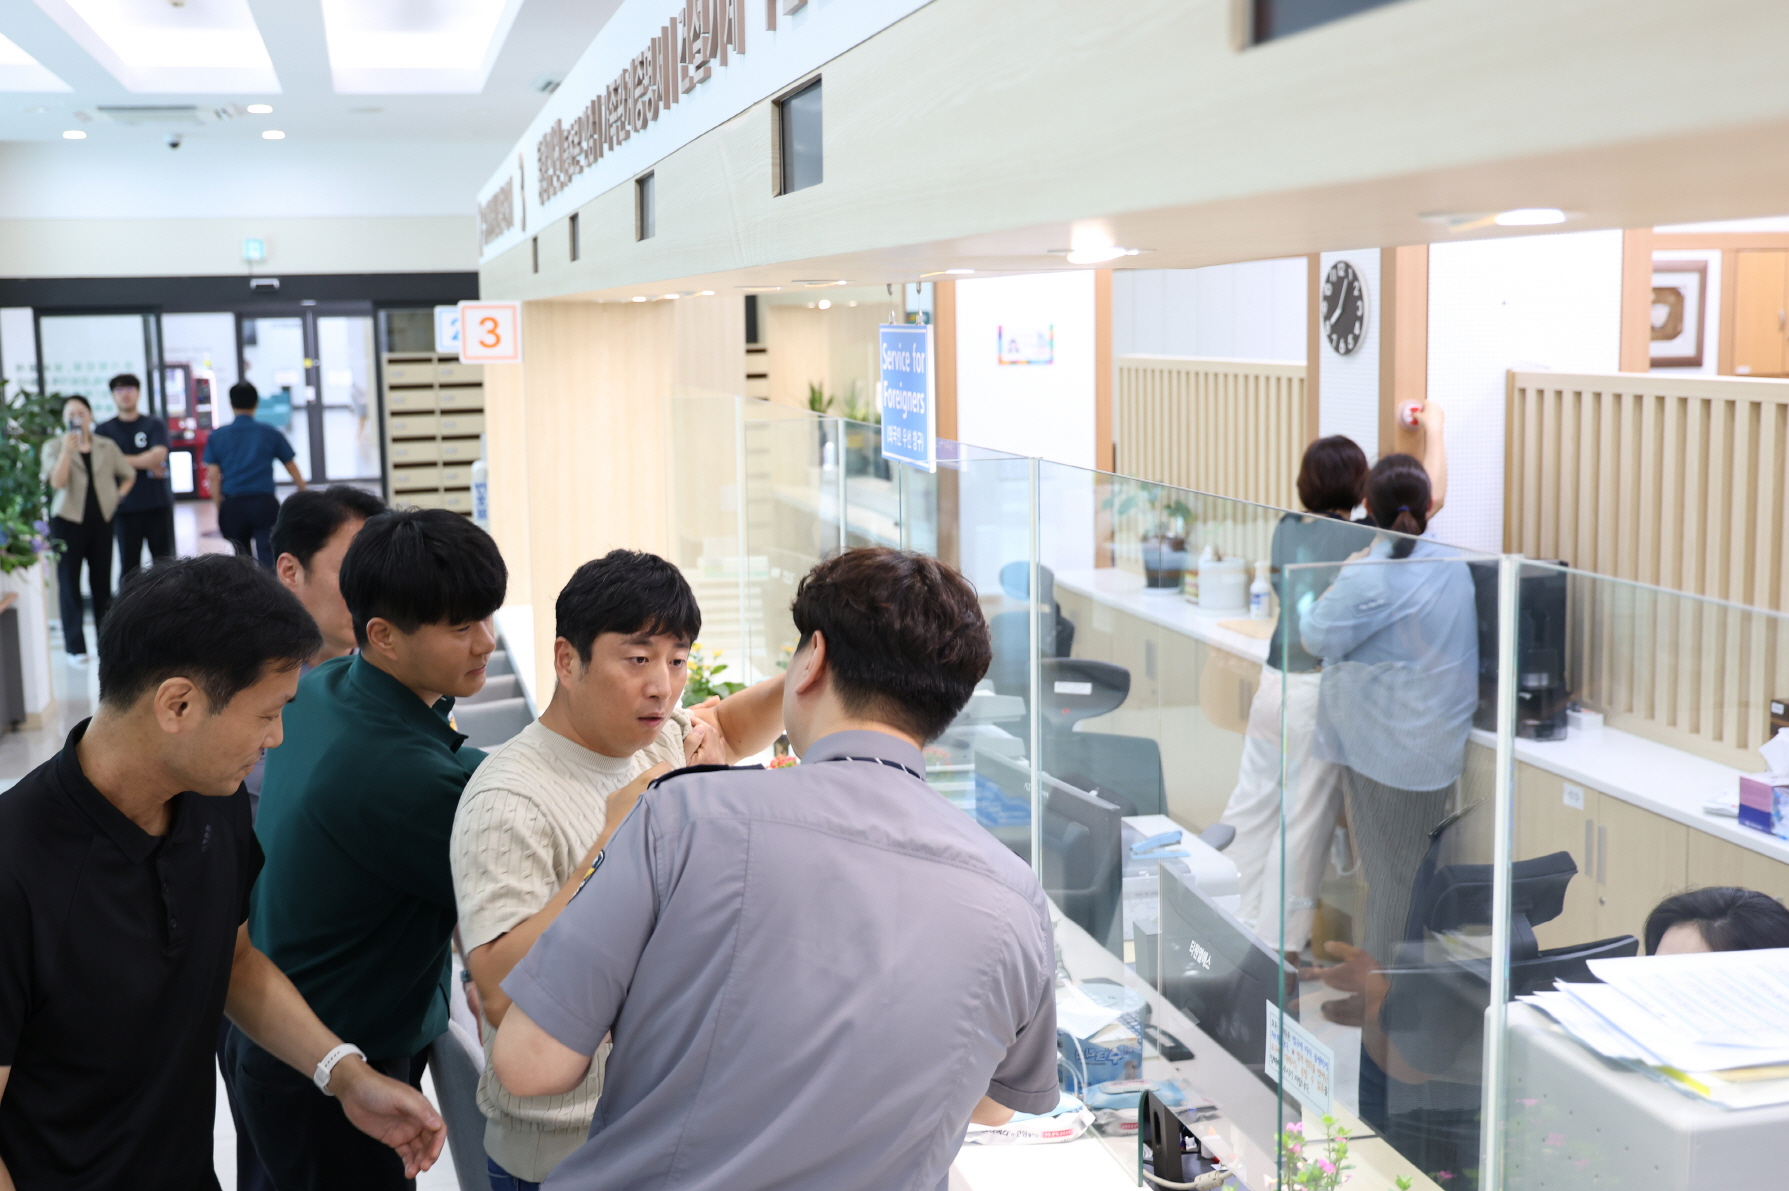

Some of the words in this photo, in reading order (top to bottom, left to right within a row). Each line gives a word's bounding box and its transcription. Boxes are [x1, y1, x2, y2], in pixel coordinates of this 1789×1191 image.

[1337, 261, 1346, 277] 12
[1353, 281, 1360, 296] 2
[1356, 299, 1363, 317] 3
[479, 316, 502, 349] 3
[1338, 337, 1346, 354] 6
[882, 342, 911, 372] Service
[912, 342, 925, 374] for
[883, 380, 925, 419] Foreigners
